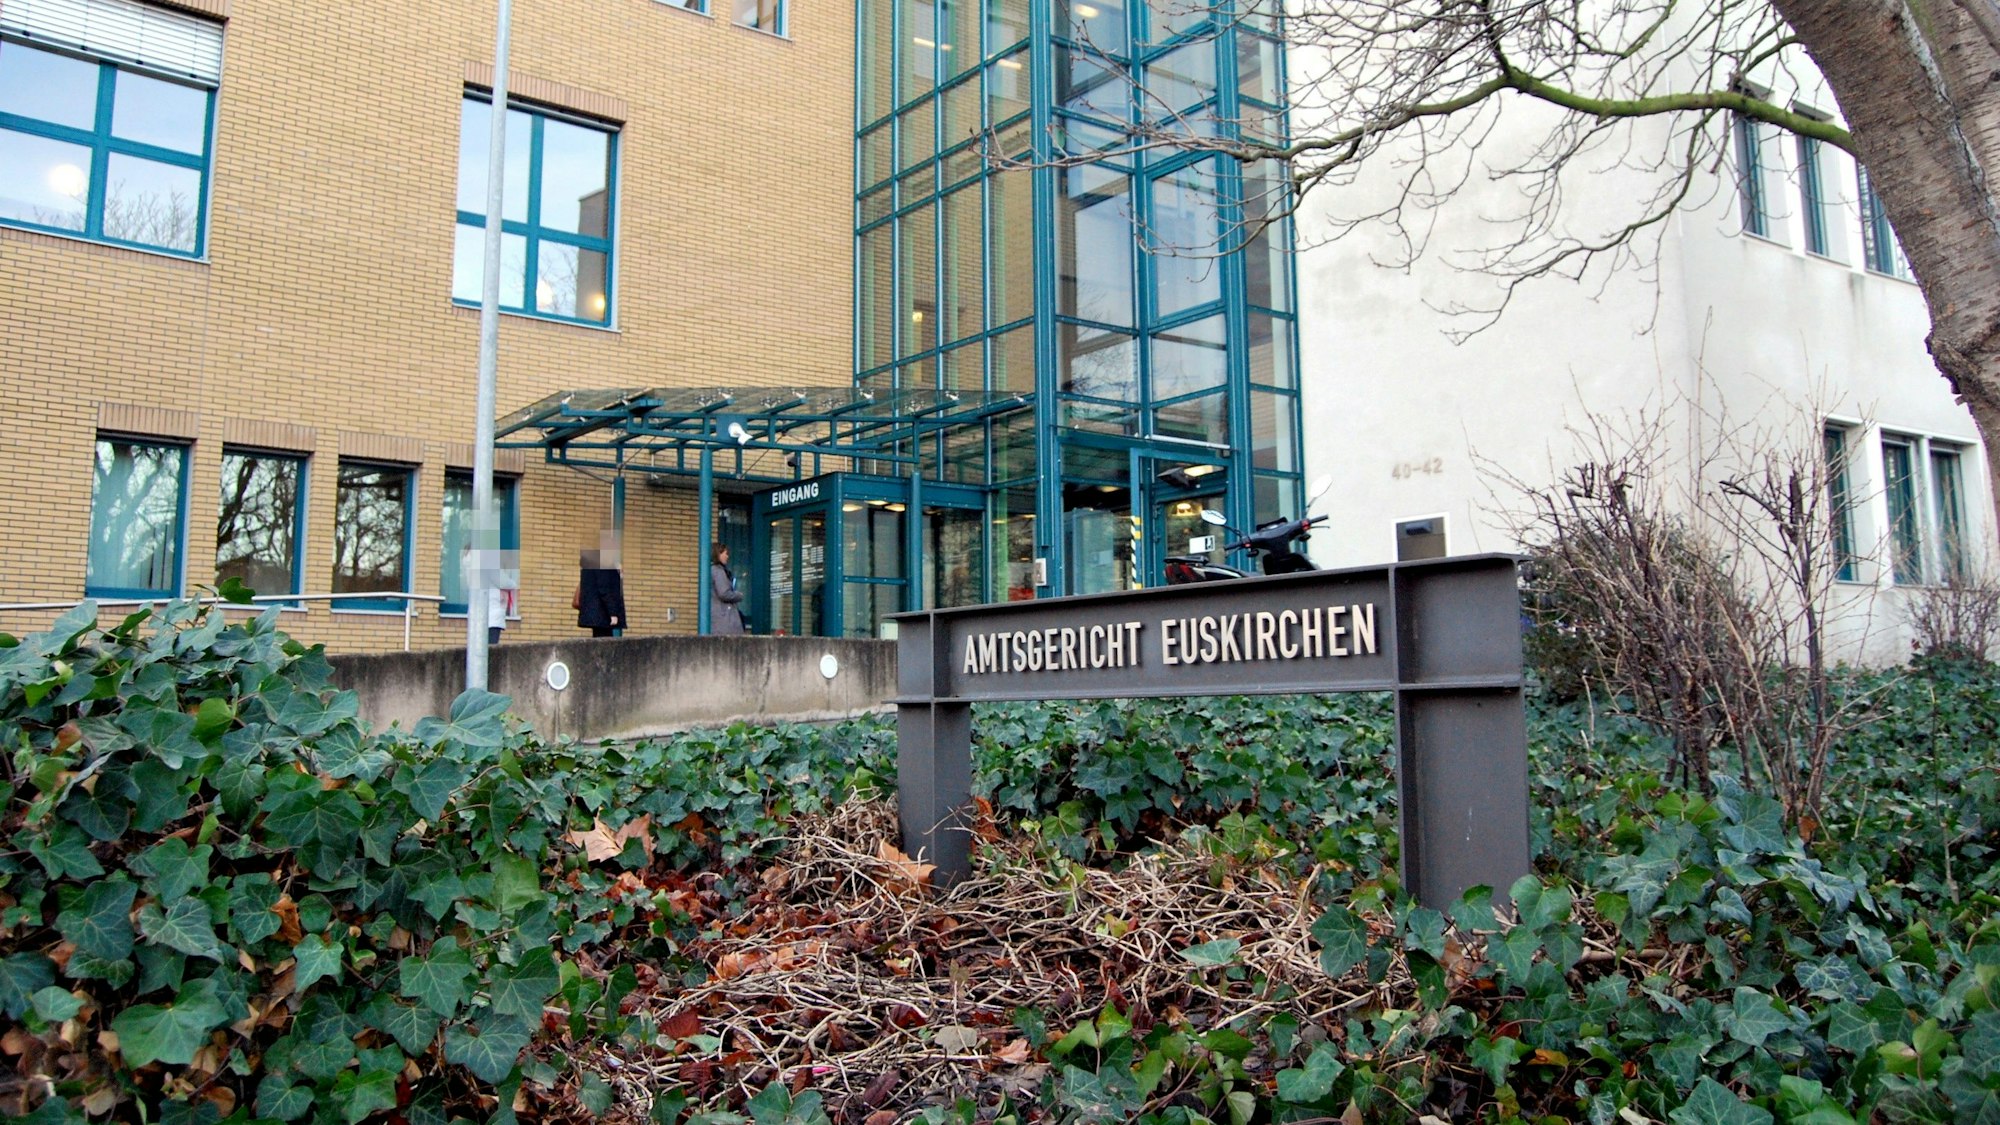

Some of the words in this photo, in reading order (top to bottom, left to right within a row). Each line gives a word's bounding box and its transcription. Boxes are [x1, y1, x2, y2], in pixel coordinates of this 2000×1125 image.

[1392, 458, 1443, 479] 40-42
[772, 483, 819, 507] EINGANG
[964, 622, 1141, 674] AMTSGERICHT
[1162, 603, 1377, 665] EUSKIRCHEN
